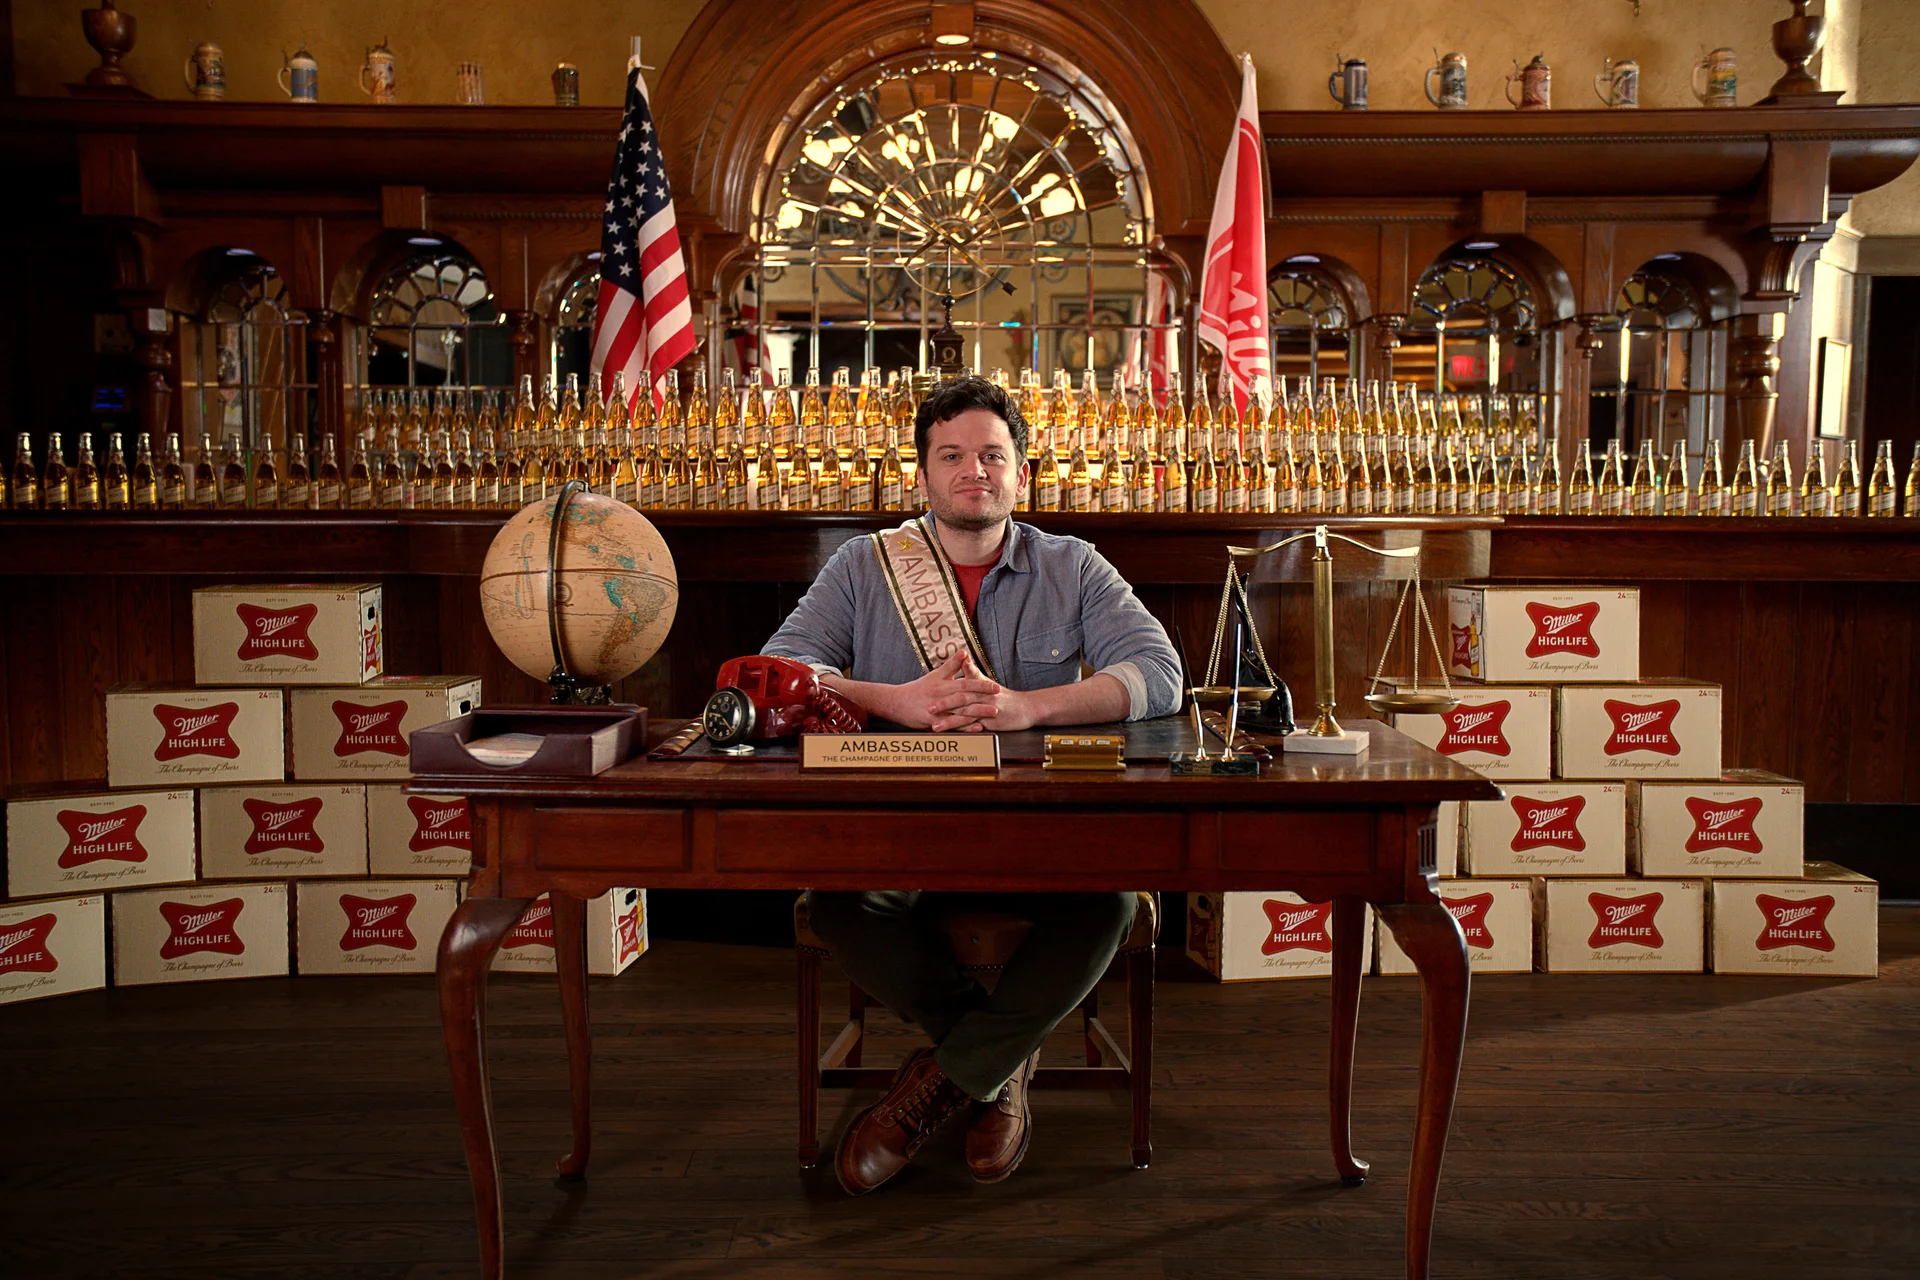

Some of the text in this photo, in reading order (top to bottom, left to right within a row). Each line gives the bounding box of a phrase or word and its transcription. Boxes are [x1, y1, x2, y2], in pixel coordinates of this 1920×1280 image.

[899, 557, 958, 663] AMBASS
[255, 615, 299, 637] Miller
[1542, 613, 1583, 635] Miller
[251, 638, 305, 648] HIGH LIFE
[1538, 636, 1588, 646] HIGH LIFE
[239, 663, 255, 673] The
[254, 663, 292, 676] Champagne
[299, 662, 318, 672] Beers
[1528, 661, 1540, 670] The
[1539, 661, 1575, 672] Champagne
[1581, 661, 1598, 670] Beers
[173, 714, 219, 737] Miller
[350, 712, 391, 733] Miller
[1453, 711, 1494, 733] Miller
[1621, 711, 1663, 732] Miller
[169, 738, 225, 748] HIGH LIFE
[346, 735, 397, 744] HIGH LIFE
[1449, 734, 1499, 744] HIGH LIFE
[1617, 733, 1668, 743] HIGH LIFE
[840, 741, 959, 752] AMBASSADOR
[336, 759, 350, 769] The
[349, 760, 385, 771] Champagne
[822, 755, 838, 763] THE
[840, 755, 890, 763] CHAMPAGNE
[892, 755, 902, 763] OF
[905, 755, 931, 763] BEERS
[1493, 760, 1510, 768] Beers
[1604, 759, 1620, 769] The
[1619, 759, 1655, 770] Champagne
[1661, 758, 1679, 767] Beers
[158, 764, 172, 774] The
[171, 764, 209, 775] Champagne
[219, 762, 239, 771] Beers
[262, 809, 305, 830] Miller
[424, 808, 465, 828] Miller
[1527, 807, 1569, 829] Miller
[1702, 808, 1745, 830] Miller
[78, 817, 126, 843] Miller
[421, 830, 471, 840] HIGH LIFE
[1523, 830, 1573, 840] HIGH LIFE
[1698, 831, 1750, 841] HIGH LIFE
[257, 832, 310, 841] HIGH LIFE
[73, 841, 133, 854] HIGH LIFE
[246, 857, 263, 866] The
[261, 858, 299, 868] Champagne
[306, 856, 324, 865] Beers
[412, 855, 427, 864] The
[425, 856, 460, 867] Champagne
[1511, 855, 1526, 864] The
[1525, 855, 1560, 867] Champagne
[1567, 855, 1584, 864] Beers
[1685, 857, 1700, 866] The
[1699, 857, 1735, 868] Champagne
[1743, 857, 1762, 866] Beers
[60, 872, 80, 881] The
[78, 870, 118, 881] Champagne
[128, 866, 147, 876] Beers
[357, 906, 398, 928] Miller
[1279, 909, 1320, 932] Miller
[1605, 904, 1646, 925] Miller
[1773, 906, 1816, 928] Miller
[179, 911, 225, 934] Miller
[352, 928, 404, 939] HIGH LIFE
[538, 928, 554, 938] LIF
[1465, 928, 1482, 937] IFE
[1600, 926, 1651, 936] HIGH LIFE
[1769, 929, 1822, 939] HIGH LIFE
[174, 934, 230, 946] HIGH LIFE
[1274, 932, 1323, 943] HIGH LIFE
[16, 952, 42, 963] LIFE
[340, 954, 356, 963] The
[355, 954, 391, 965] Champagne
[397, 953, 416, 962] Beers
[503, 952, 516, 961] The
[514, 953, 547, 964] Champagne
[1477, 952, 1492, 961] Beers
[1589, 951, 1603, 961] The
[1602, 952, 1637, 963] Champagne
[1644, 951, 1662, 960] Beers
[1756, 954, 1770, 963] The
[1769, 955, 1806, 965] Champagne
[1813, 955, 1834, 964] Beers
[162, 962, 177, 972] The
[177, 961, 217, 972] Champagne
[225, 959, 243, 968] Beers
[1261, 959, 1276, 968] The
[1275, 958, 1309, 970] Champagne
[36, 977, 56, 987] Beers
